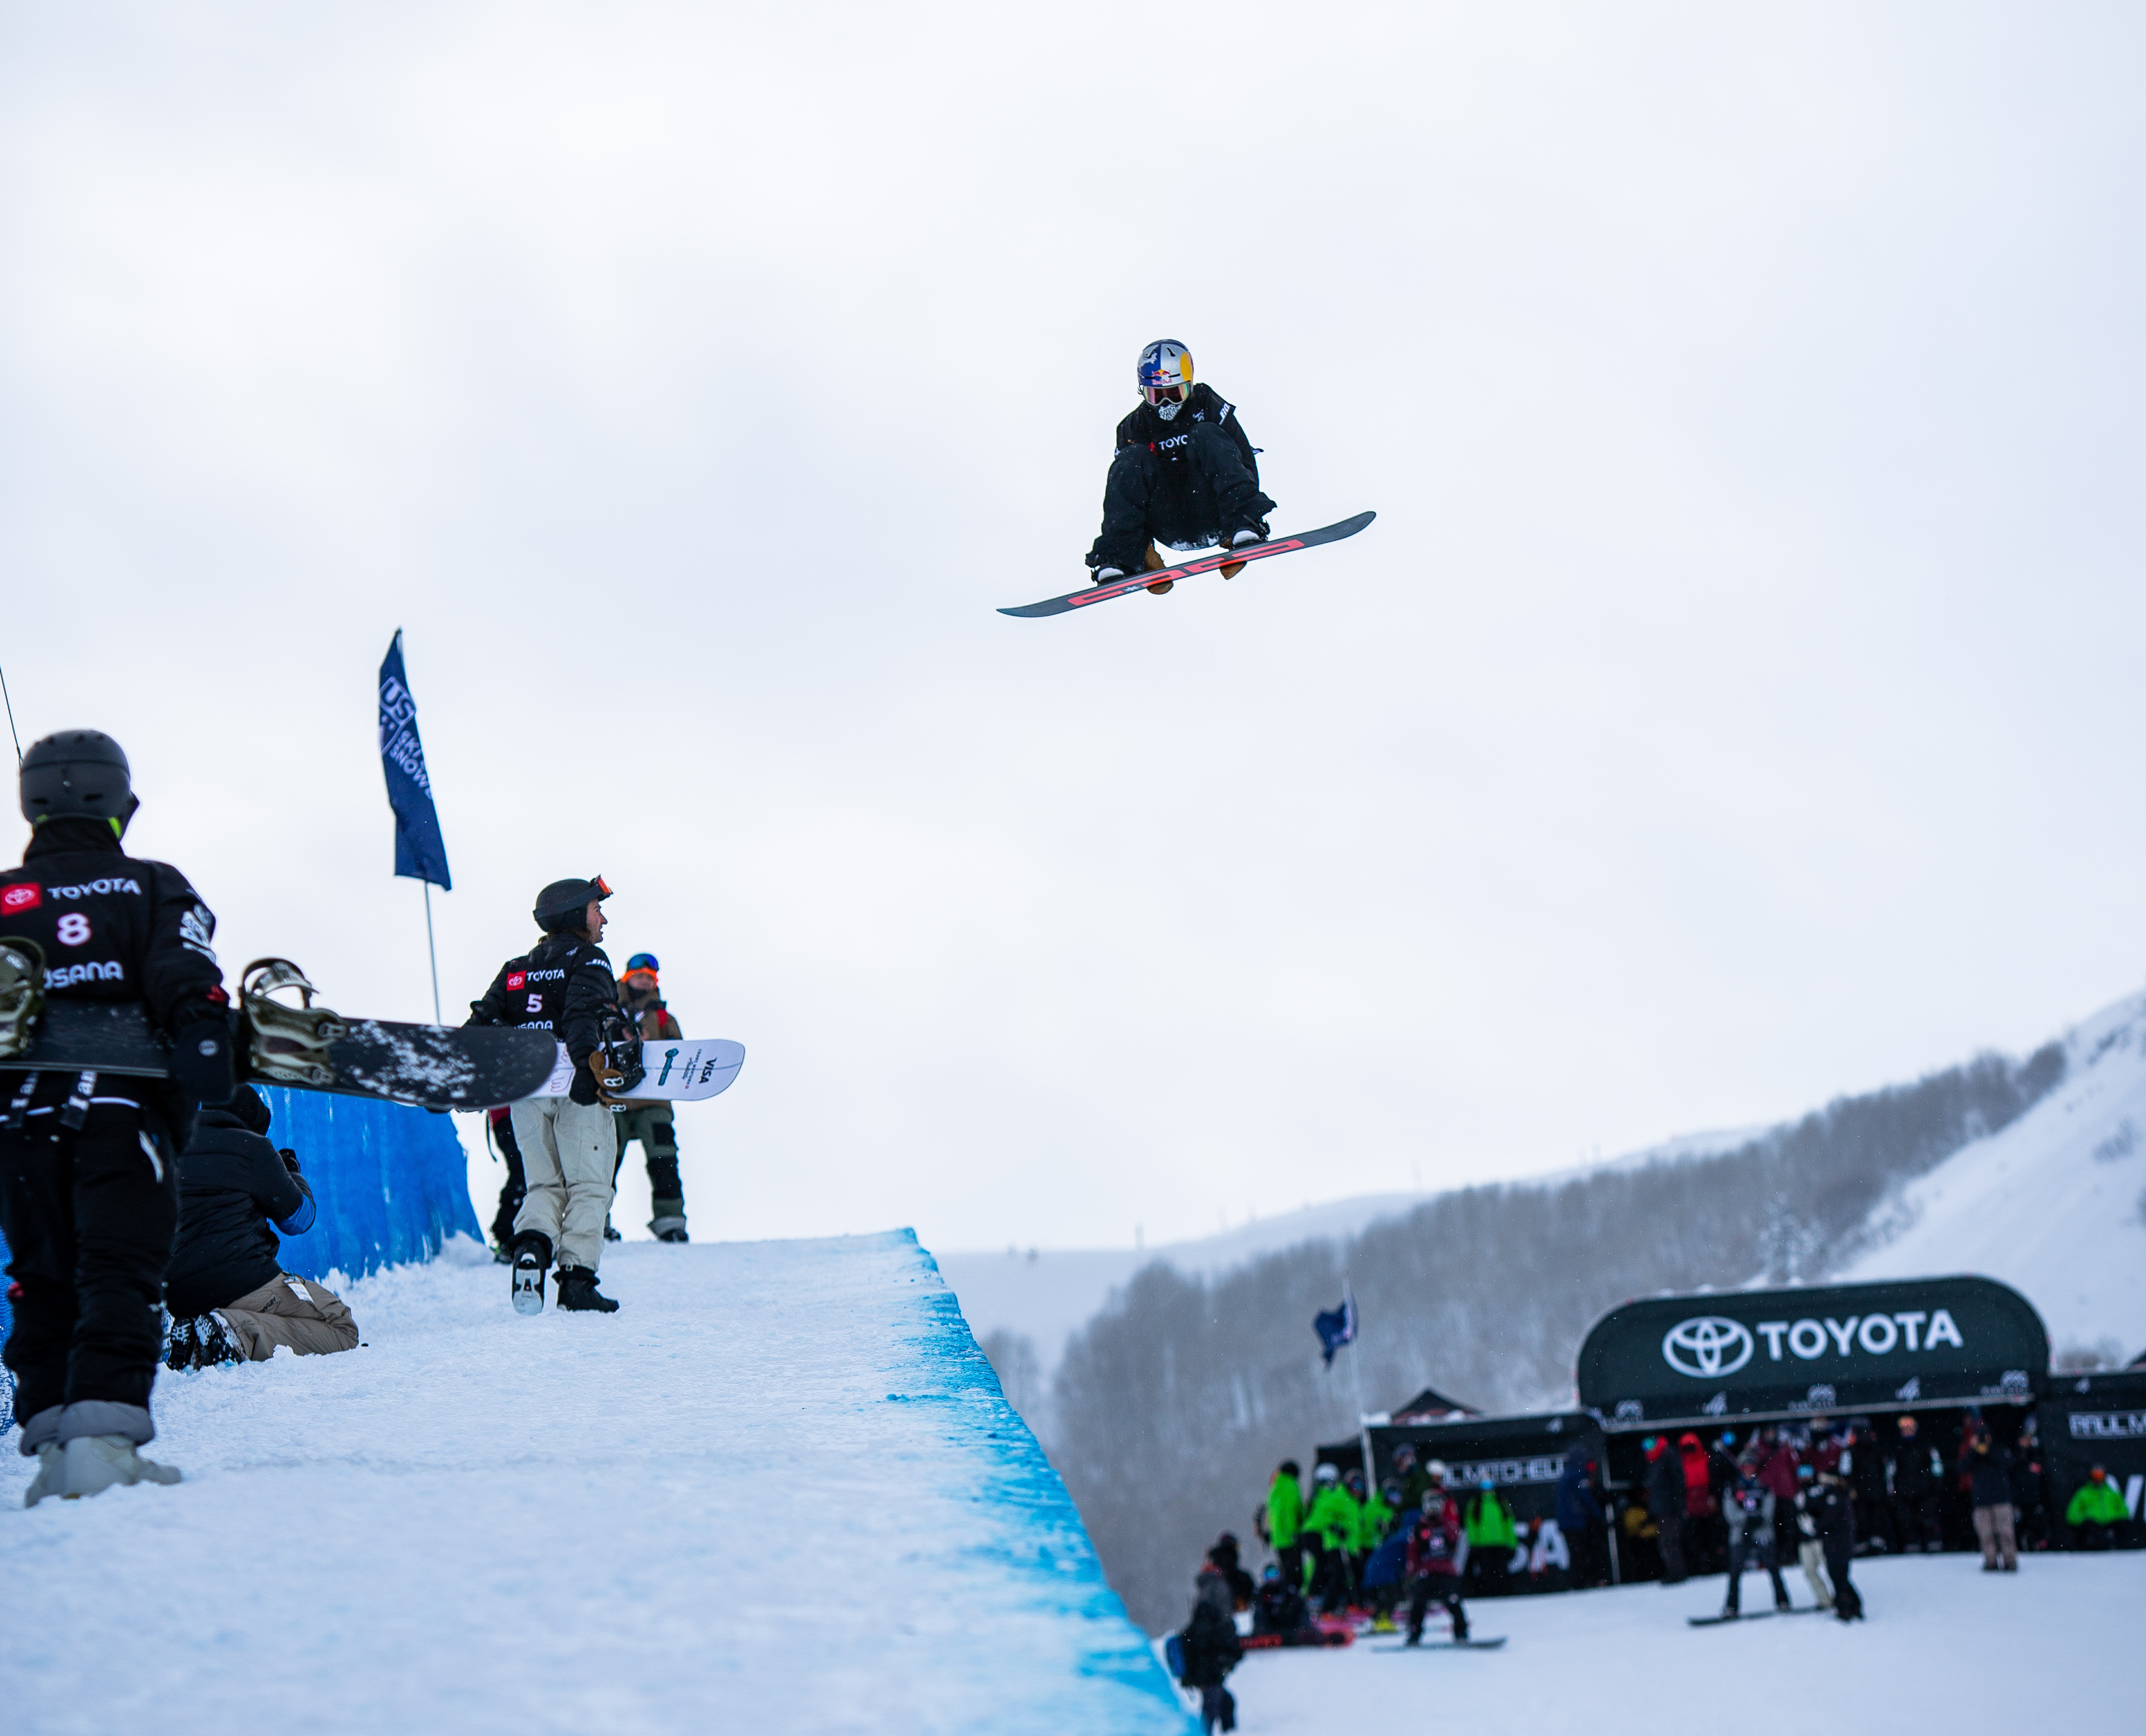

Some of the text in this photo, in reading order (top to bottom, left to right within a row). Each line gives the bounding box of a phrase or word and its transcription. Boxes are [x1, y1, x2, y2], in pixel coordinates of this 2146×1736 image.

[381, 681, 412, 721] US
[47, 878, 141, 899] TOYOTA
[57, 913, 91, 946] 8
[526, 969, 564, 981] TOYOTA
[526, 993, 543, 1013] 5
[699, 1056, 718, 1084] VISA
[1755, 1308, 1964, 1362] TOYOTA
